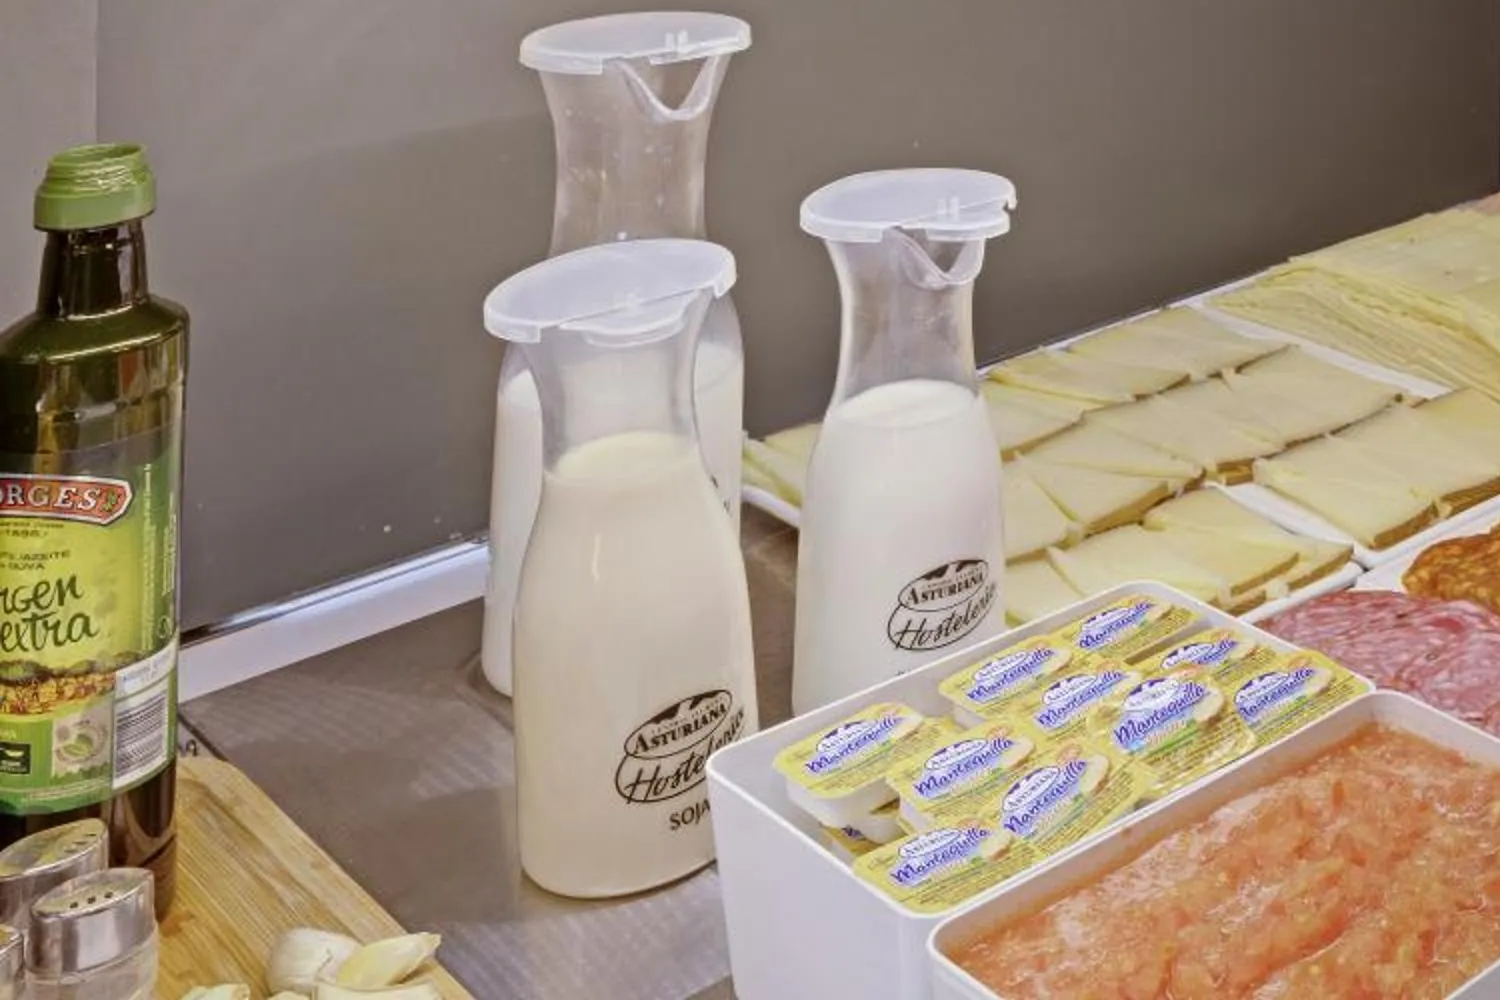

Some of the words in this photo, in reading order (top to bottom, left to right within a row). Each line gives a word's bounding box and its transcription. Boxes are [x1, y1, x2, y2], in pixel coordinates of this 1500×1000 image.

[0, 483, 101, 510] RGES
[1, 611, 100, 652] extra
[631, 703, 727, 755] ASTURIANA
[1113, 681, 1205, 745] Mantequilla
[804, 715, 900, 772] Mantequilla
[914, 738, 1013, 794] Mantequilla
[1004, 760, 1085, 833] Mantequilla
[890, 827, 987, 882] Mantequilla
